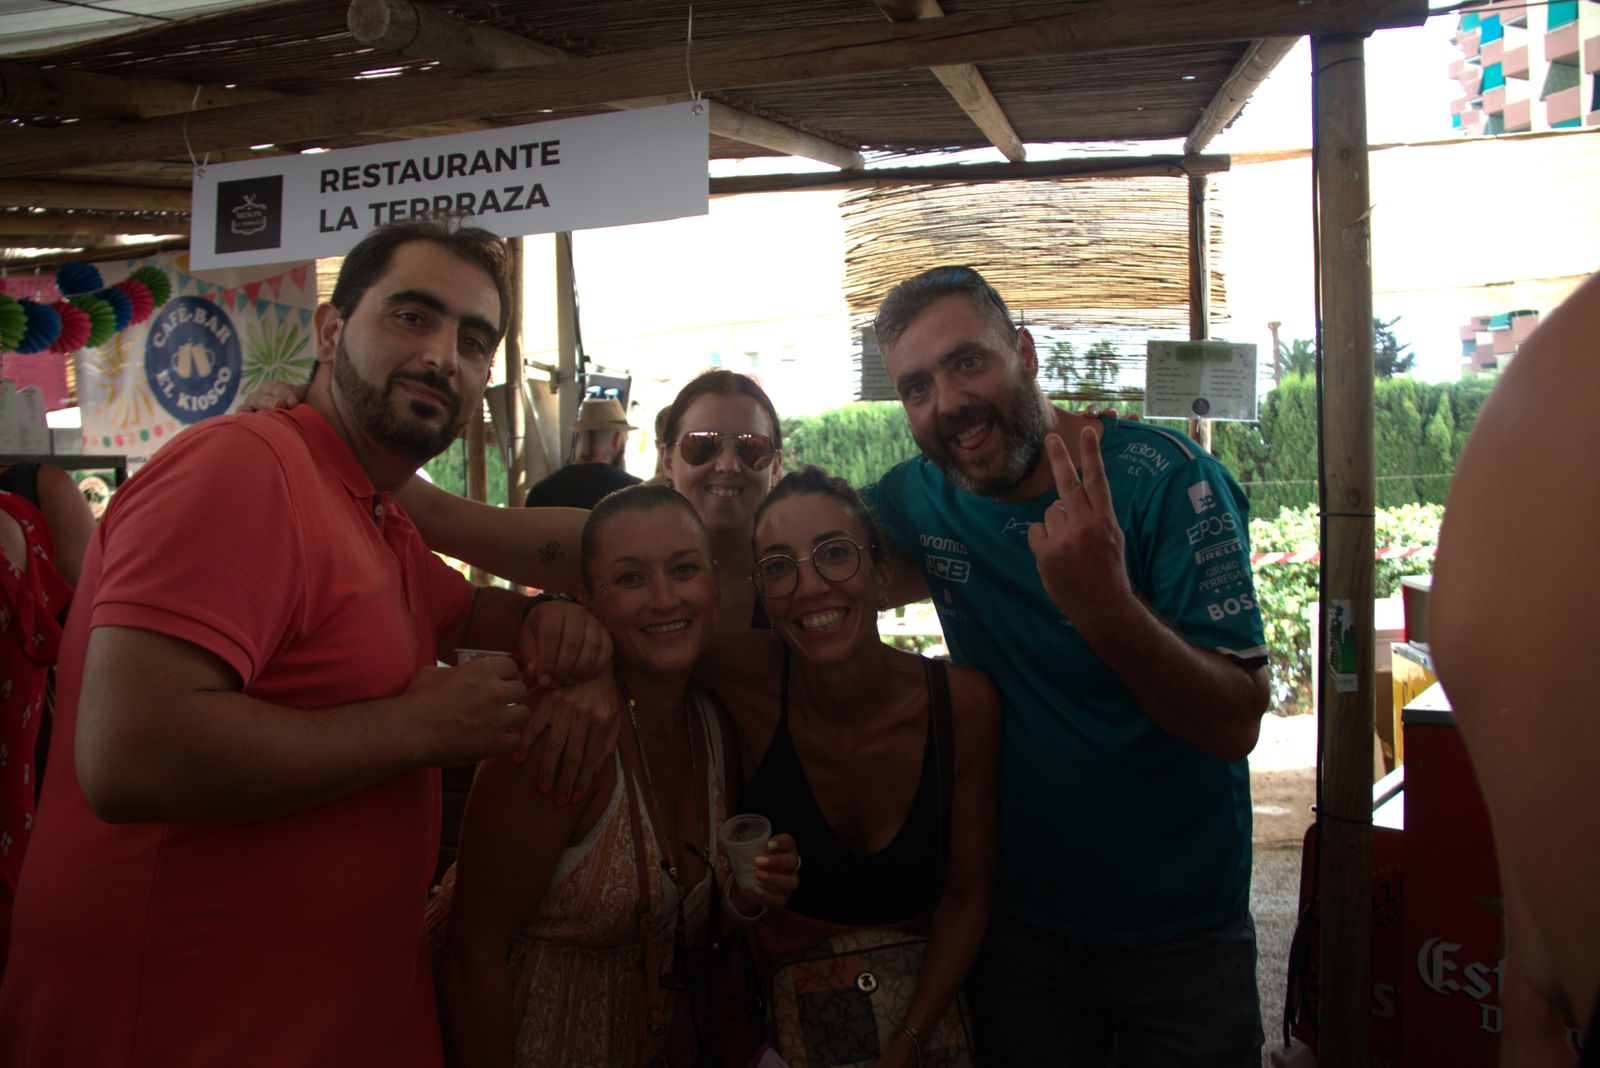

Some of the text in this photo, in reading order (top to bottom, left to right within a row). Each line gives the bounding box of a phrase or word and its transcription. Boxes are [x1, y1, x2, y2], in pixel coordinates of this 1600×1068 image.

[319, 139, 560, 193] RESTAURANTE
[319, 183, 550, 233] LA TERRRAZA
[156, 366, 232, 411] EL KIOSCO
[919, 533, 970, 555] aramco
[1186, 512, 1236, 546] EPOS
[1206, 560, 1239, 577] GIRARD
